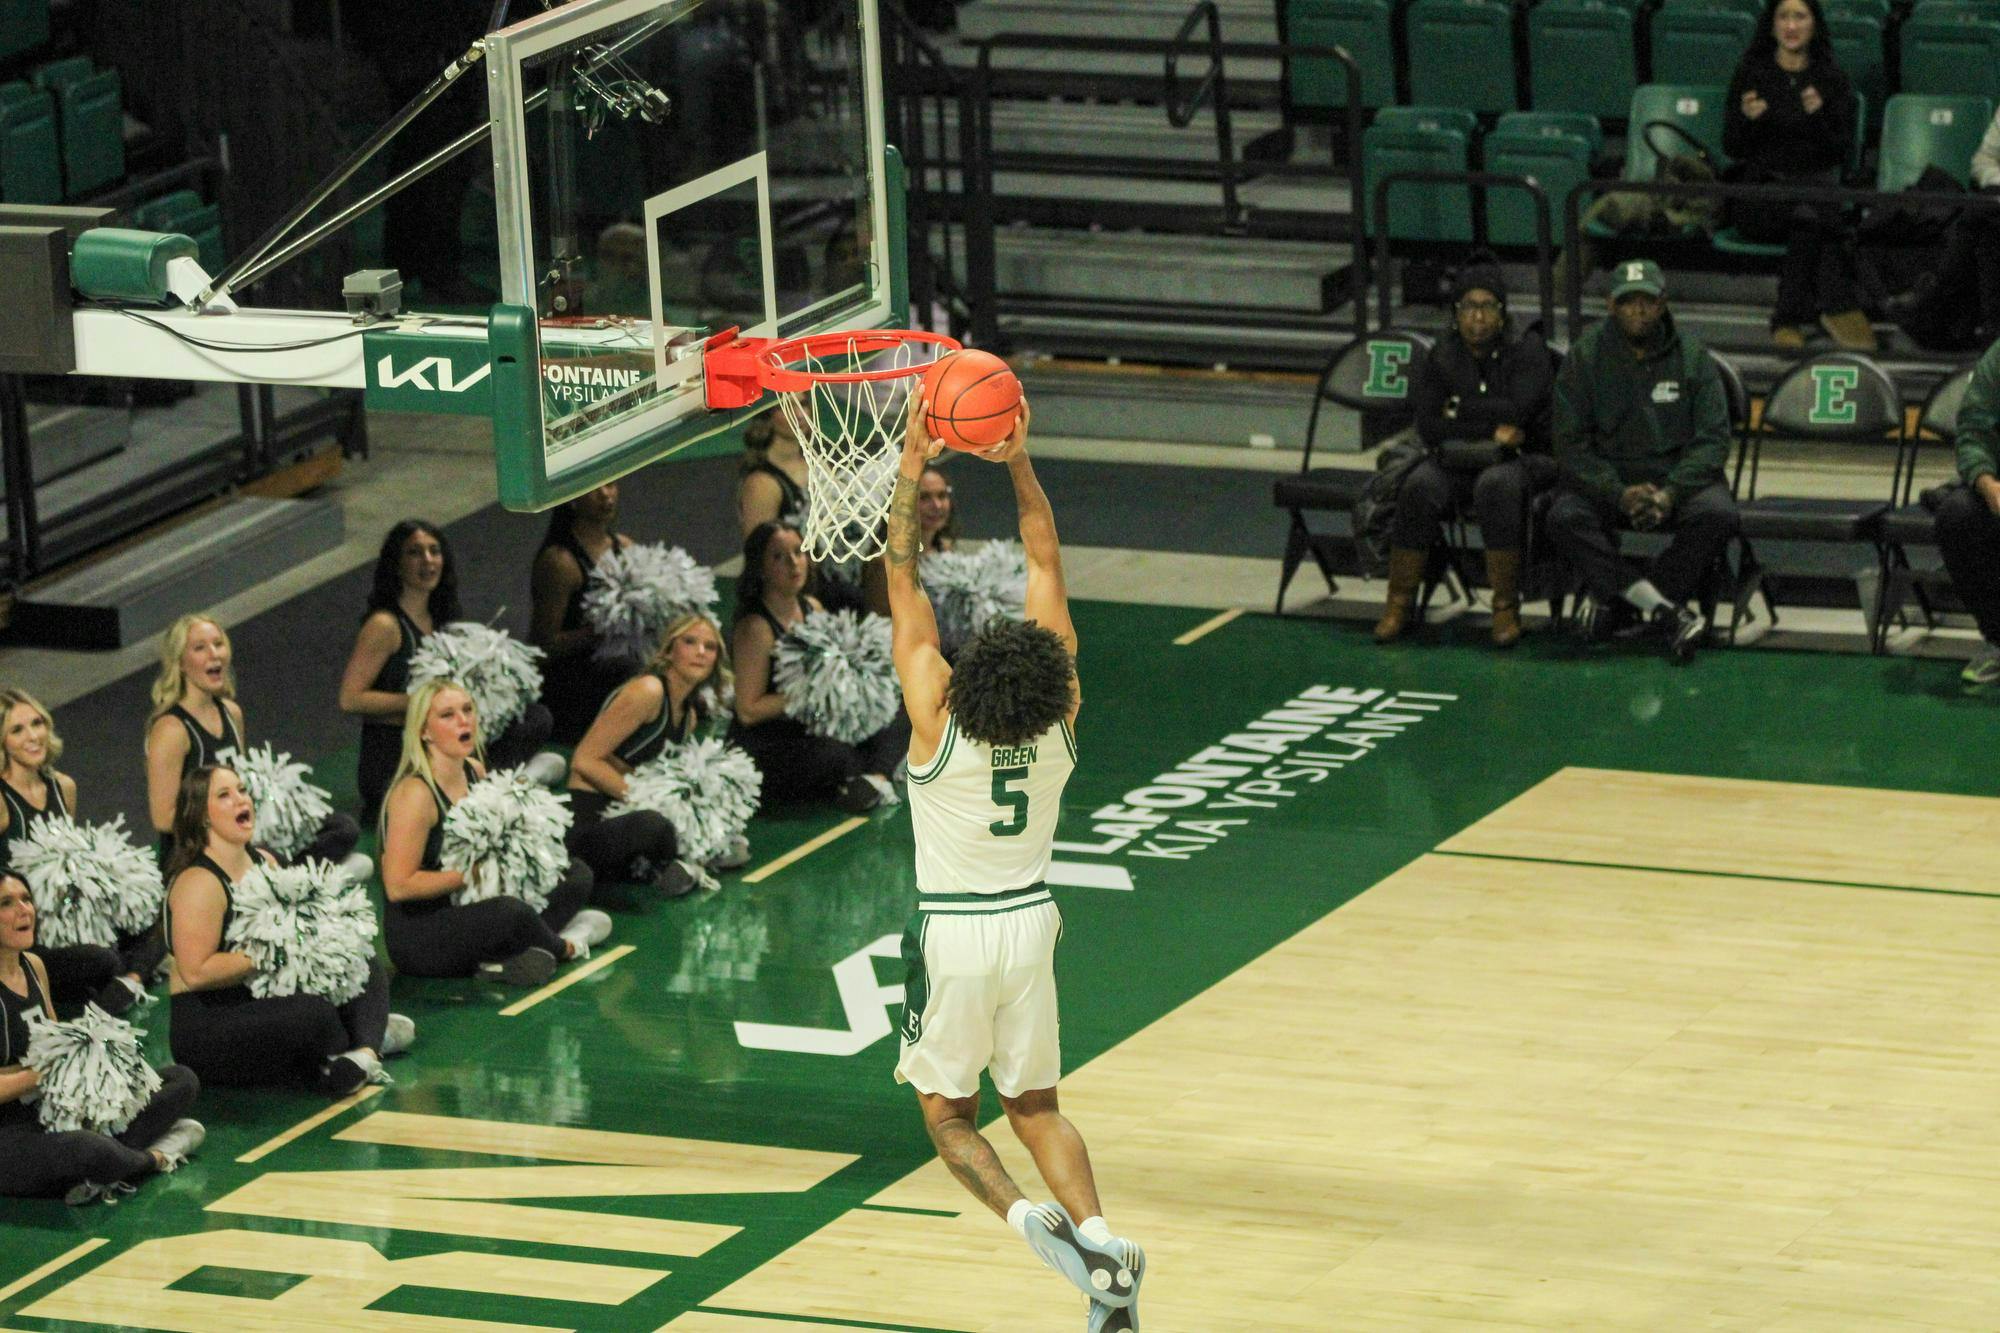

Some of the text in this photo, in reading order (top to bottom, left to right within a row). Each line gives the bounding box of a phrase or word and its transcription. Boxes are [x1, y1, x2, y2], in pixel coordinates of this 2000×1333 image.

[1626, 262, 1644, 281] E
[1363, 340, 1412, 398] E
[1809, 365, 1859, 424] E
[991, 745, 1038, 768] GREEN
[1052, 684, 1385, 855] LAFONTAINE
[1127, 690, 1459, 860] KIA YPSILANTI
[989, 766, 1029, 837] 5
